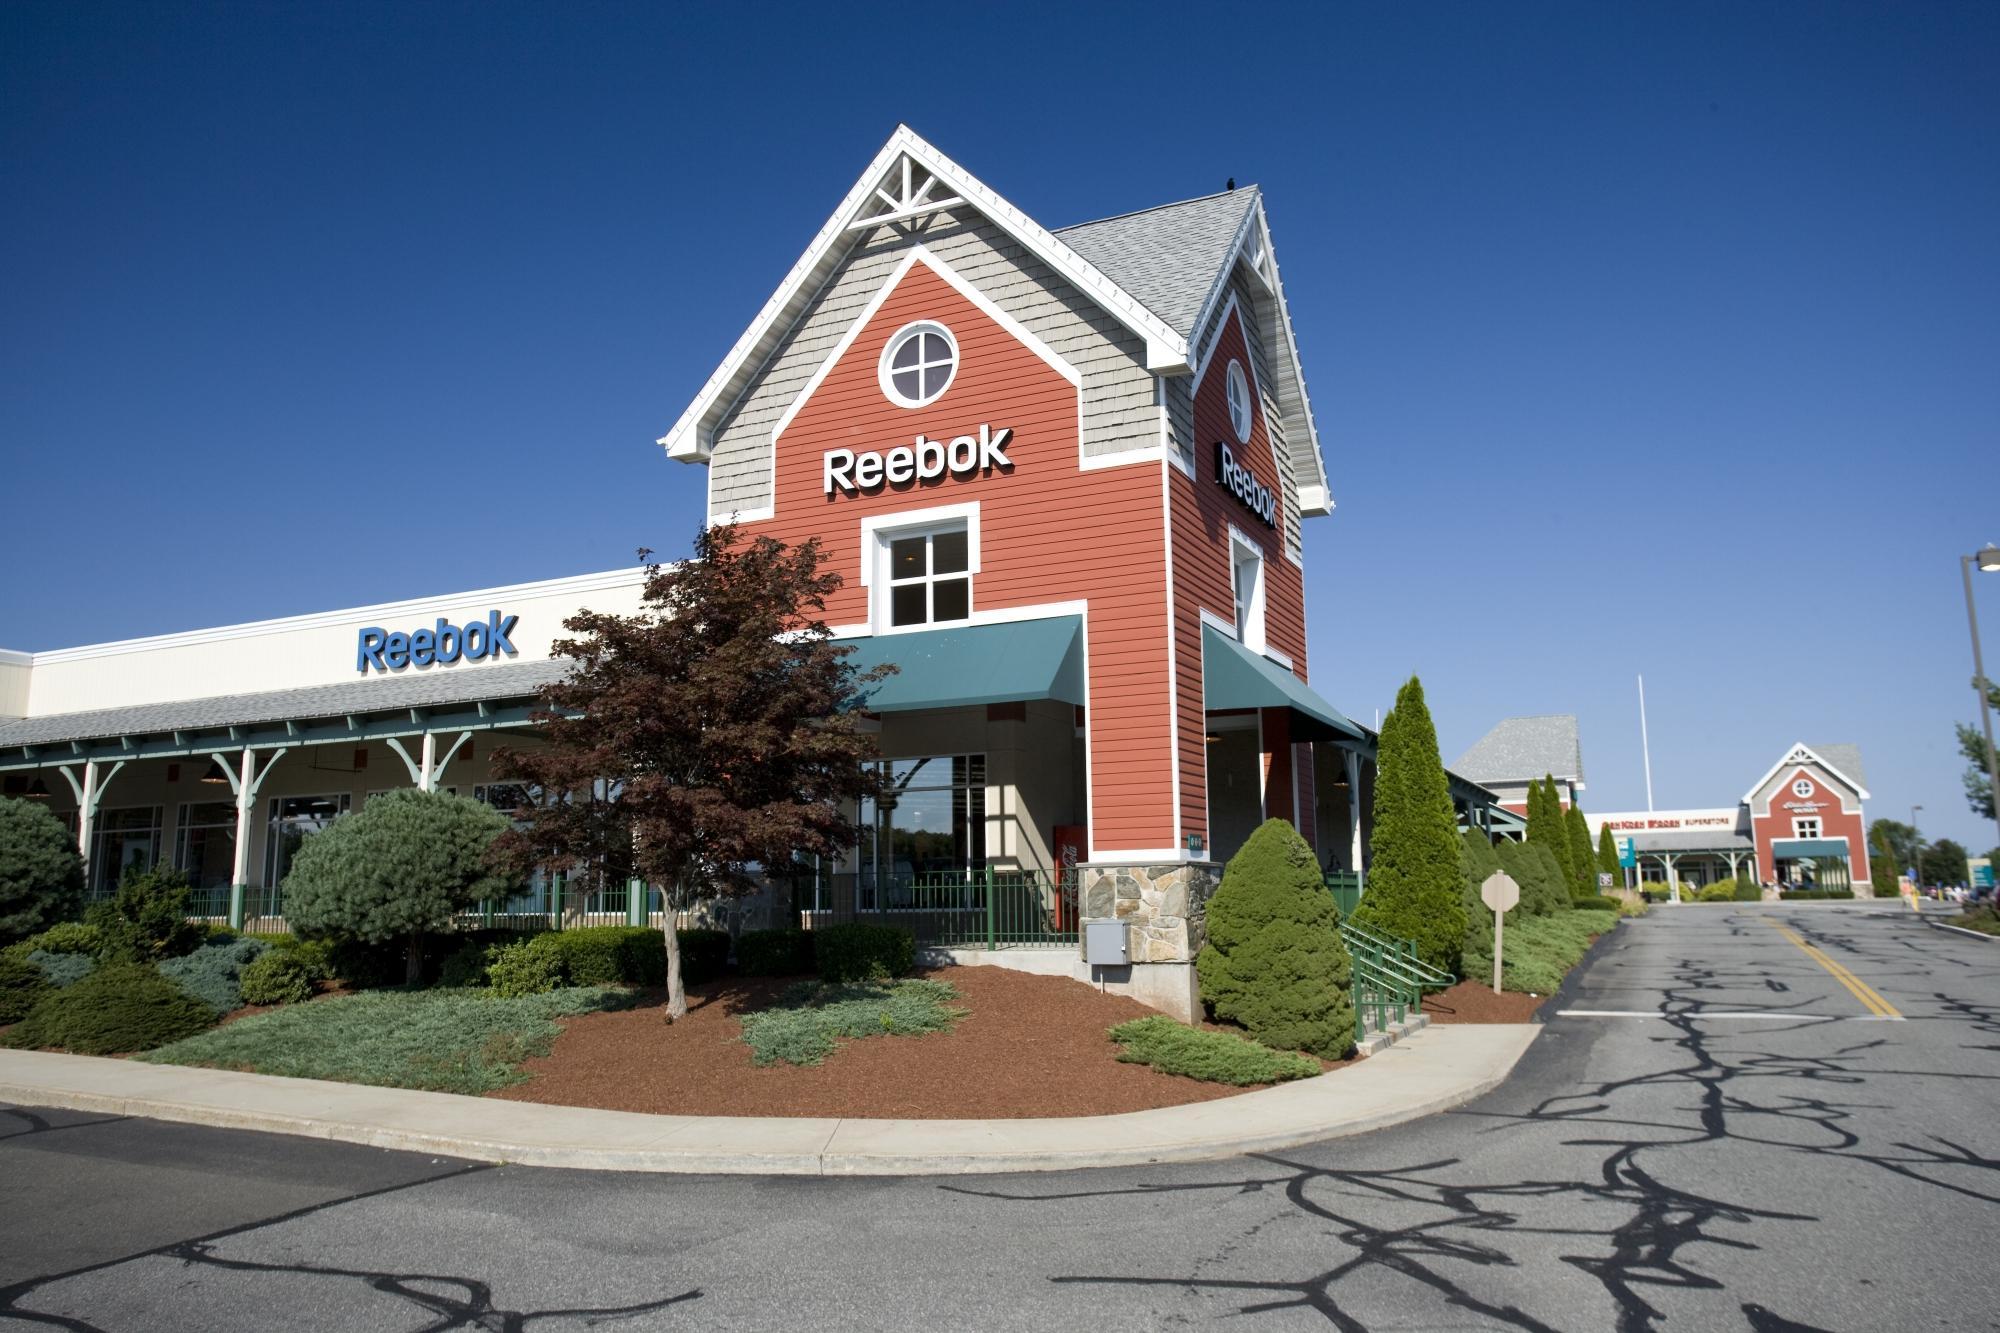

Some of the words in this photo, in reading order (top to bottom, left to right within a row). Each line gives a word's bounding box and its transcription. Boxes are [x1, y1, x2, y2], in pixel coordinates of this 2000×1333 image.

[824, 423, 1014, 494] Reebok
[1219, 440, 1277, 529] Reebok
[357, 609, 519, 672] Reebok
